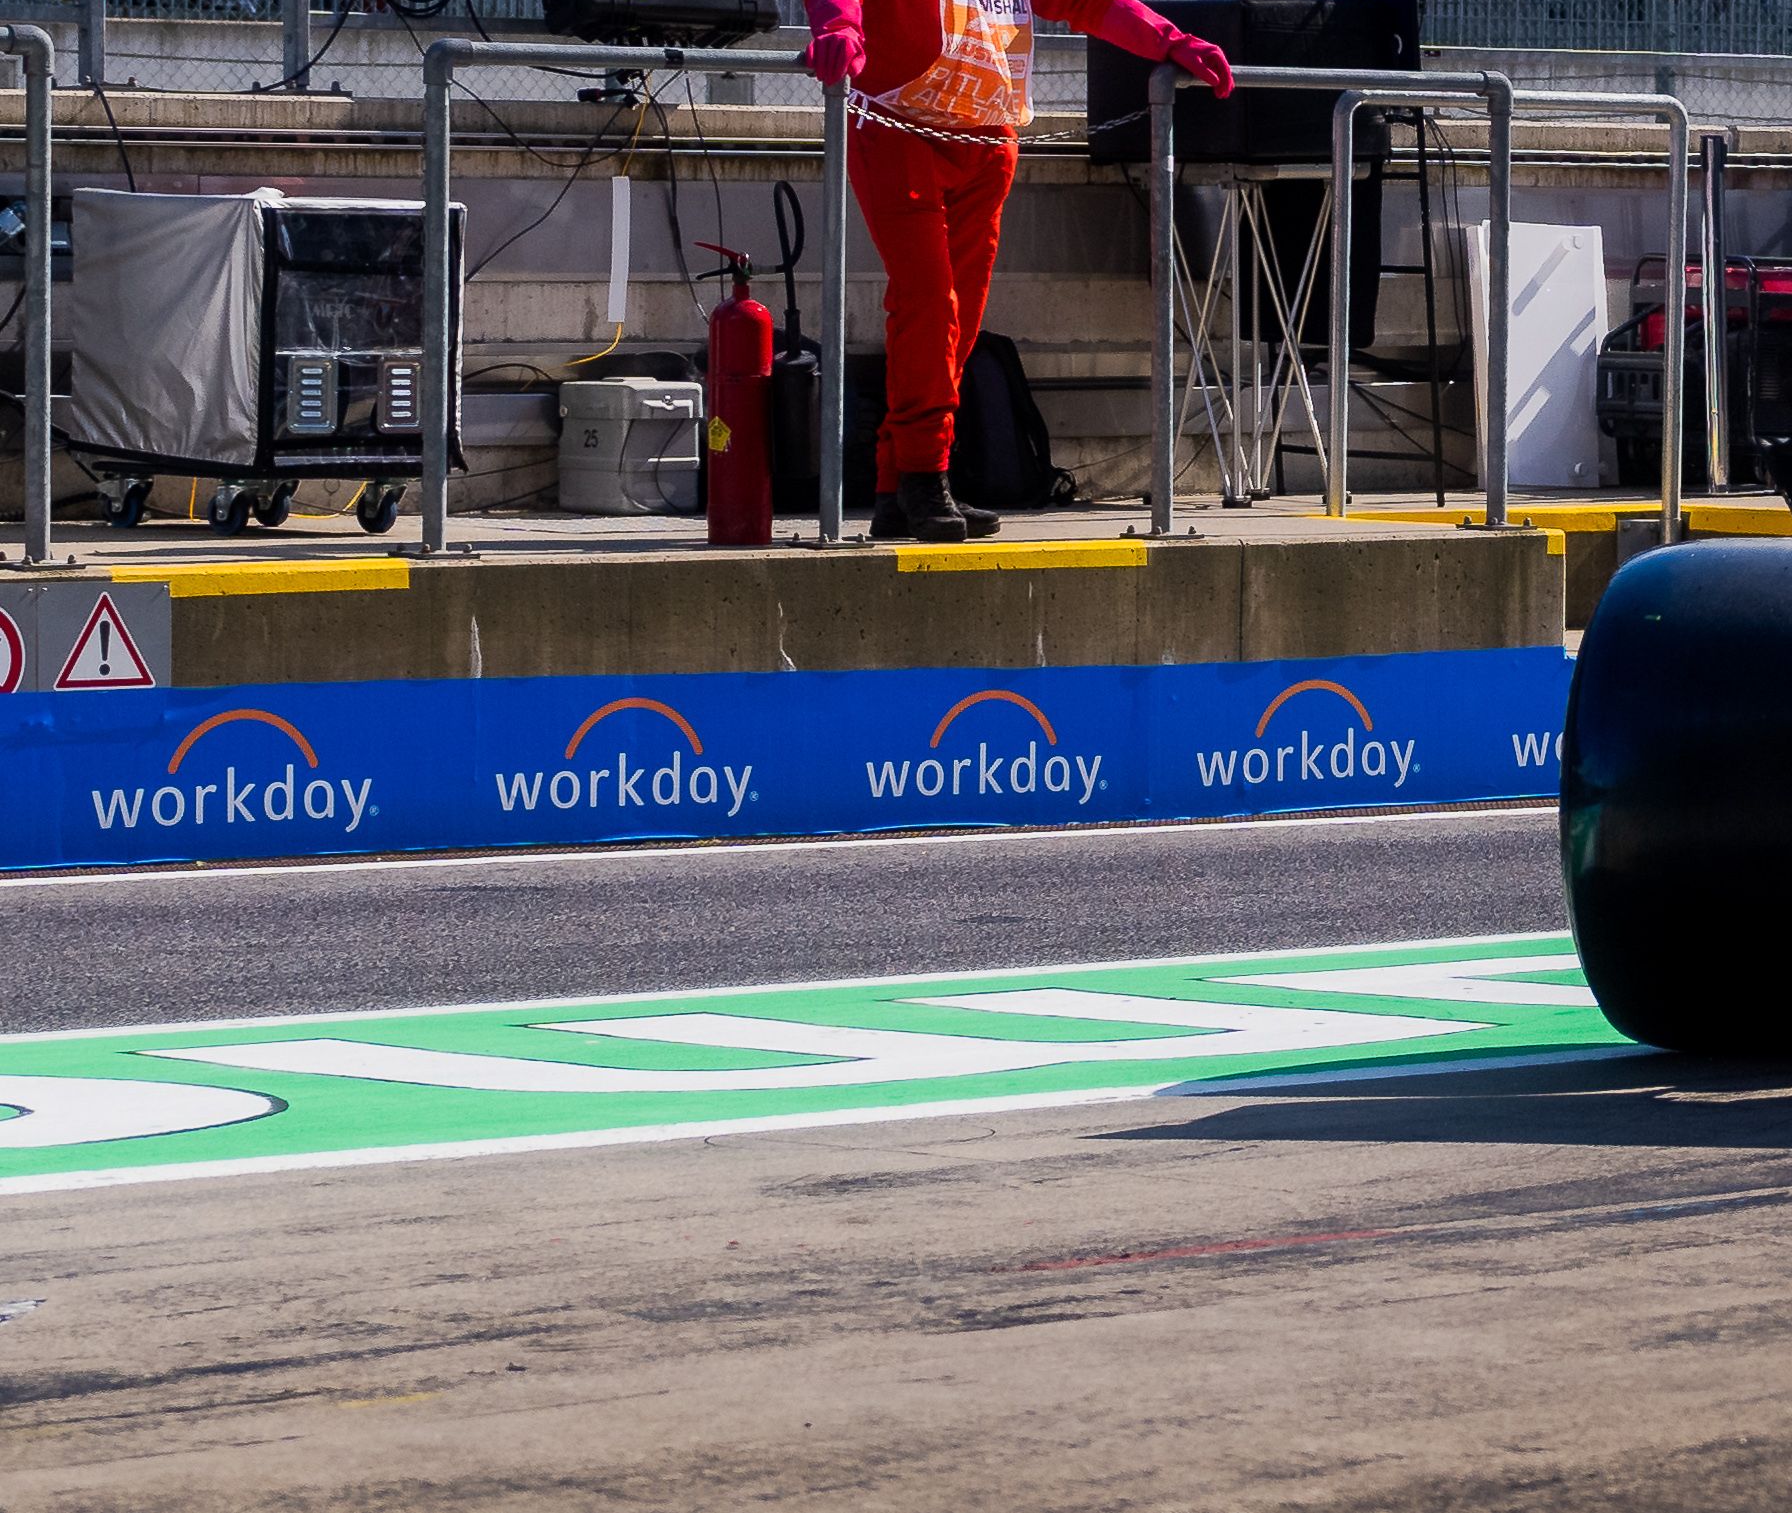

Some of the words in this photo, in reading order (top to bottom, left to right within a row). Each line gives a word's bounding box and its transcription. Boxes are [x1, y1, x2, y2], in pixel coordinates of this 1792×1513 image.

[584, 429, 599, 448] 25
[496, 751, 753, 817] workday
[866, 742, 1102, 804] workday
[1197, 729, 1415, 790] workday
[93, 764, 372, 832] workday
